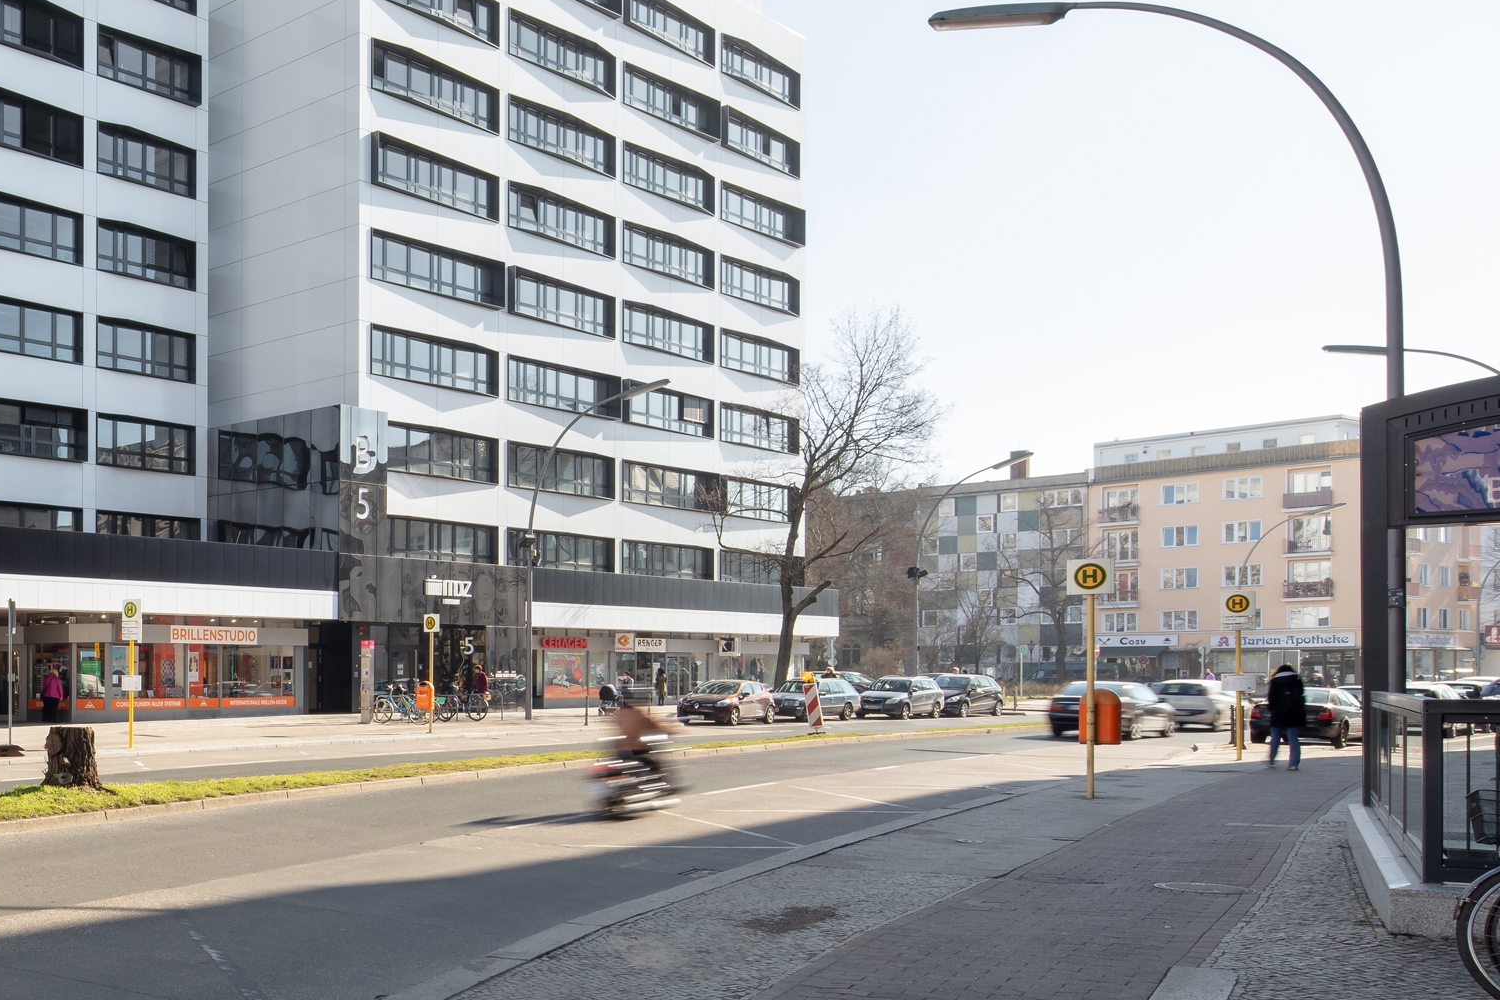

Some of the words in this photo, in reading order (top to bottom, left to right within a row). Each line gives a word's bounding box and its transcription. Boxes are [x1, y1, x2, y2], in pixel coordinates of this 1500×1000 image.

[356, 435, 370, 468] B
[356, 487, 370, 519] 5
[1082, 569, 1098, 583] H
[1231, 598, 1243, 609] H
[172, 628, 256, 642] BRILLENSTUDIO
[1119, 637, 1146, 646] Cosy
[463, 637, 475, 655] 5
[541, 637, 589, 649] CERAGEM
